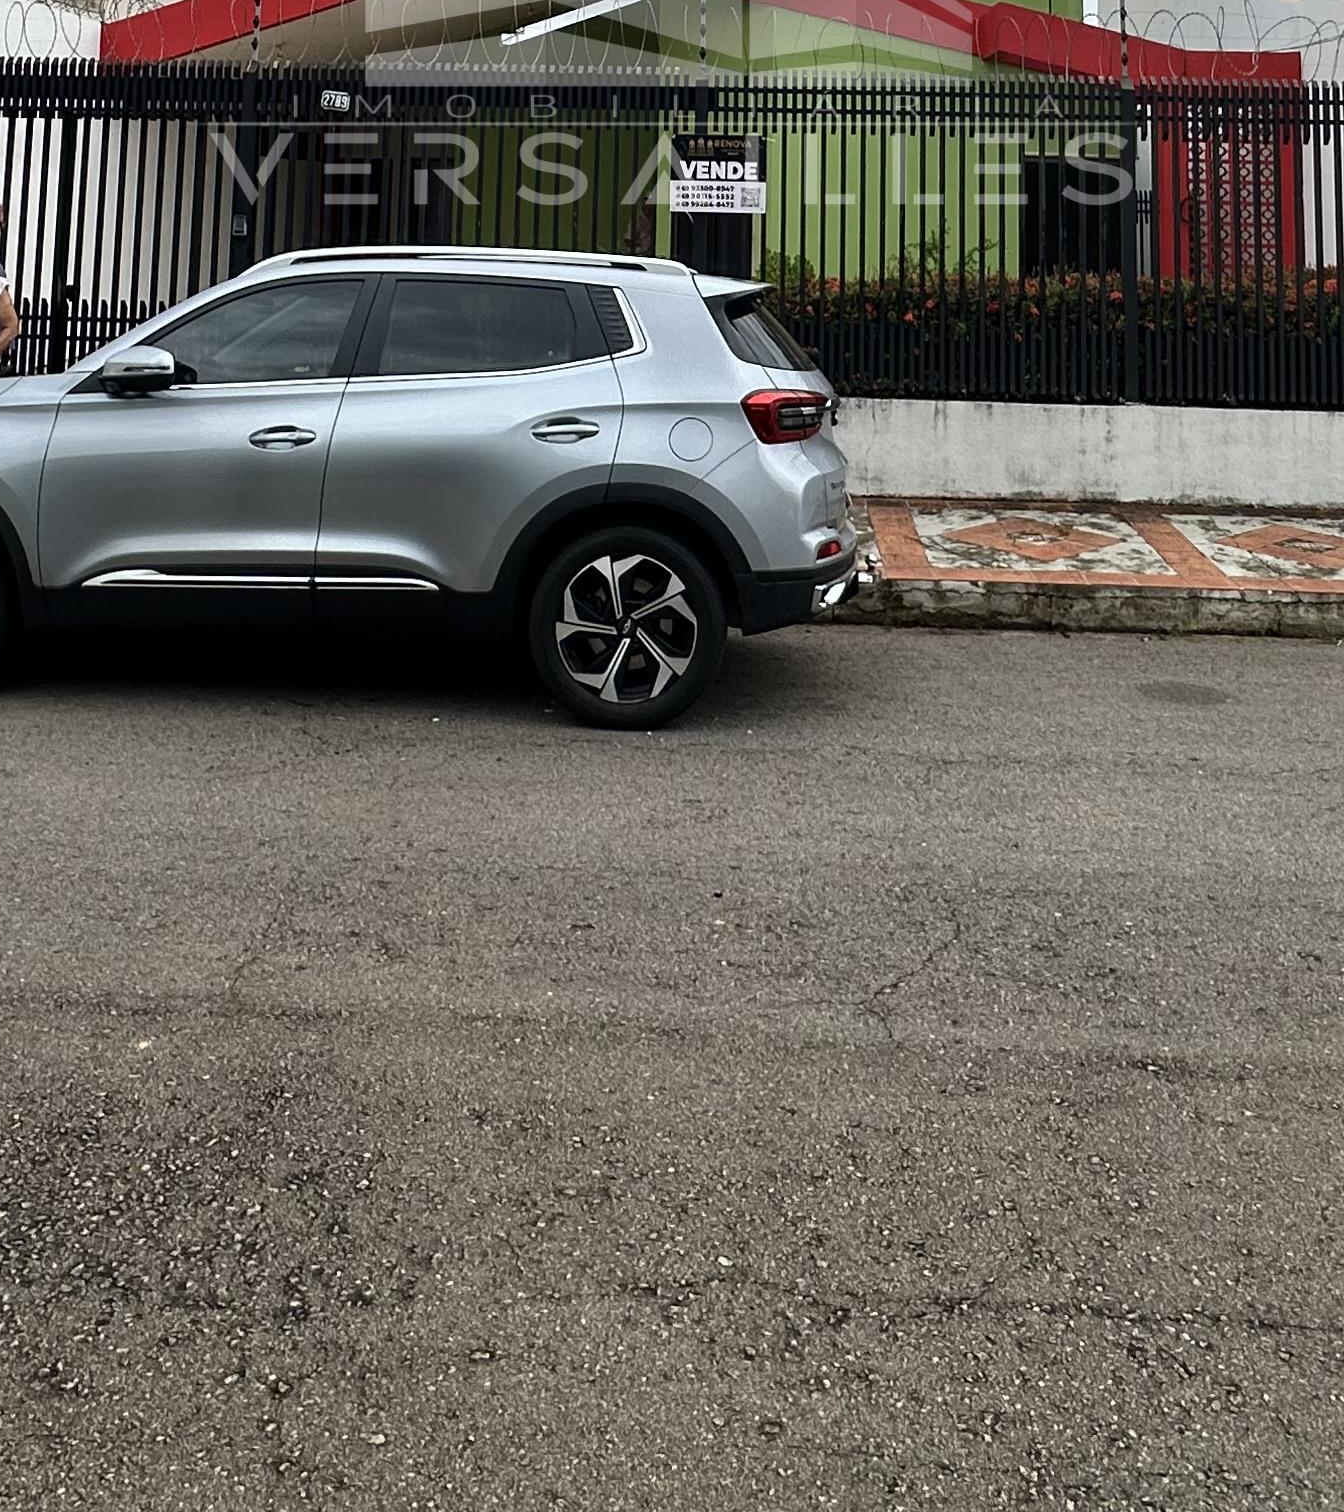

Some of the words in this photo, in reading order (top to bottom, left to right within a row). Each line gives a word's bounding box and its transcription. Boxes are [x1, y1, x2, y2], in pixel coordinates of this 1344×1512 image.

[323, 93, 347, 108] 2789
[714, 139, 752, 148] RENOVA
[680, 160, 758, 180] VENDE
